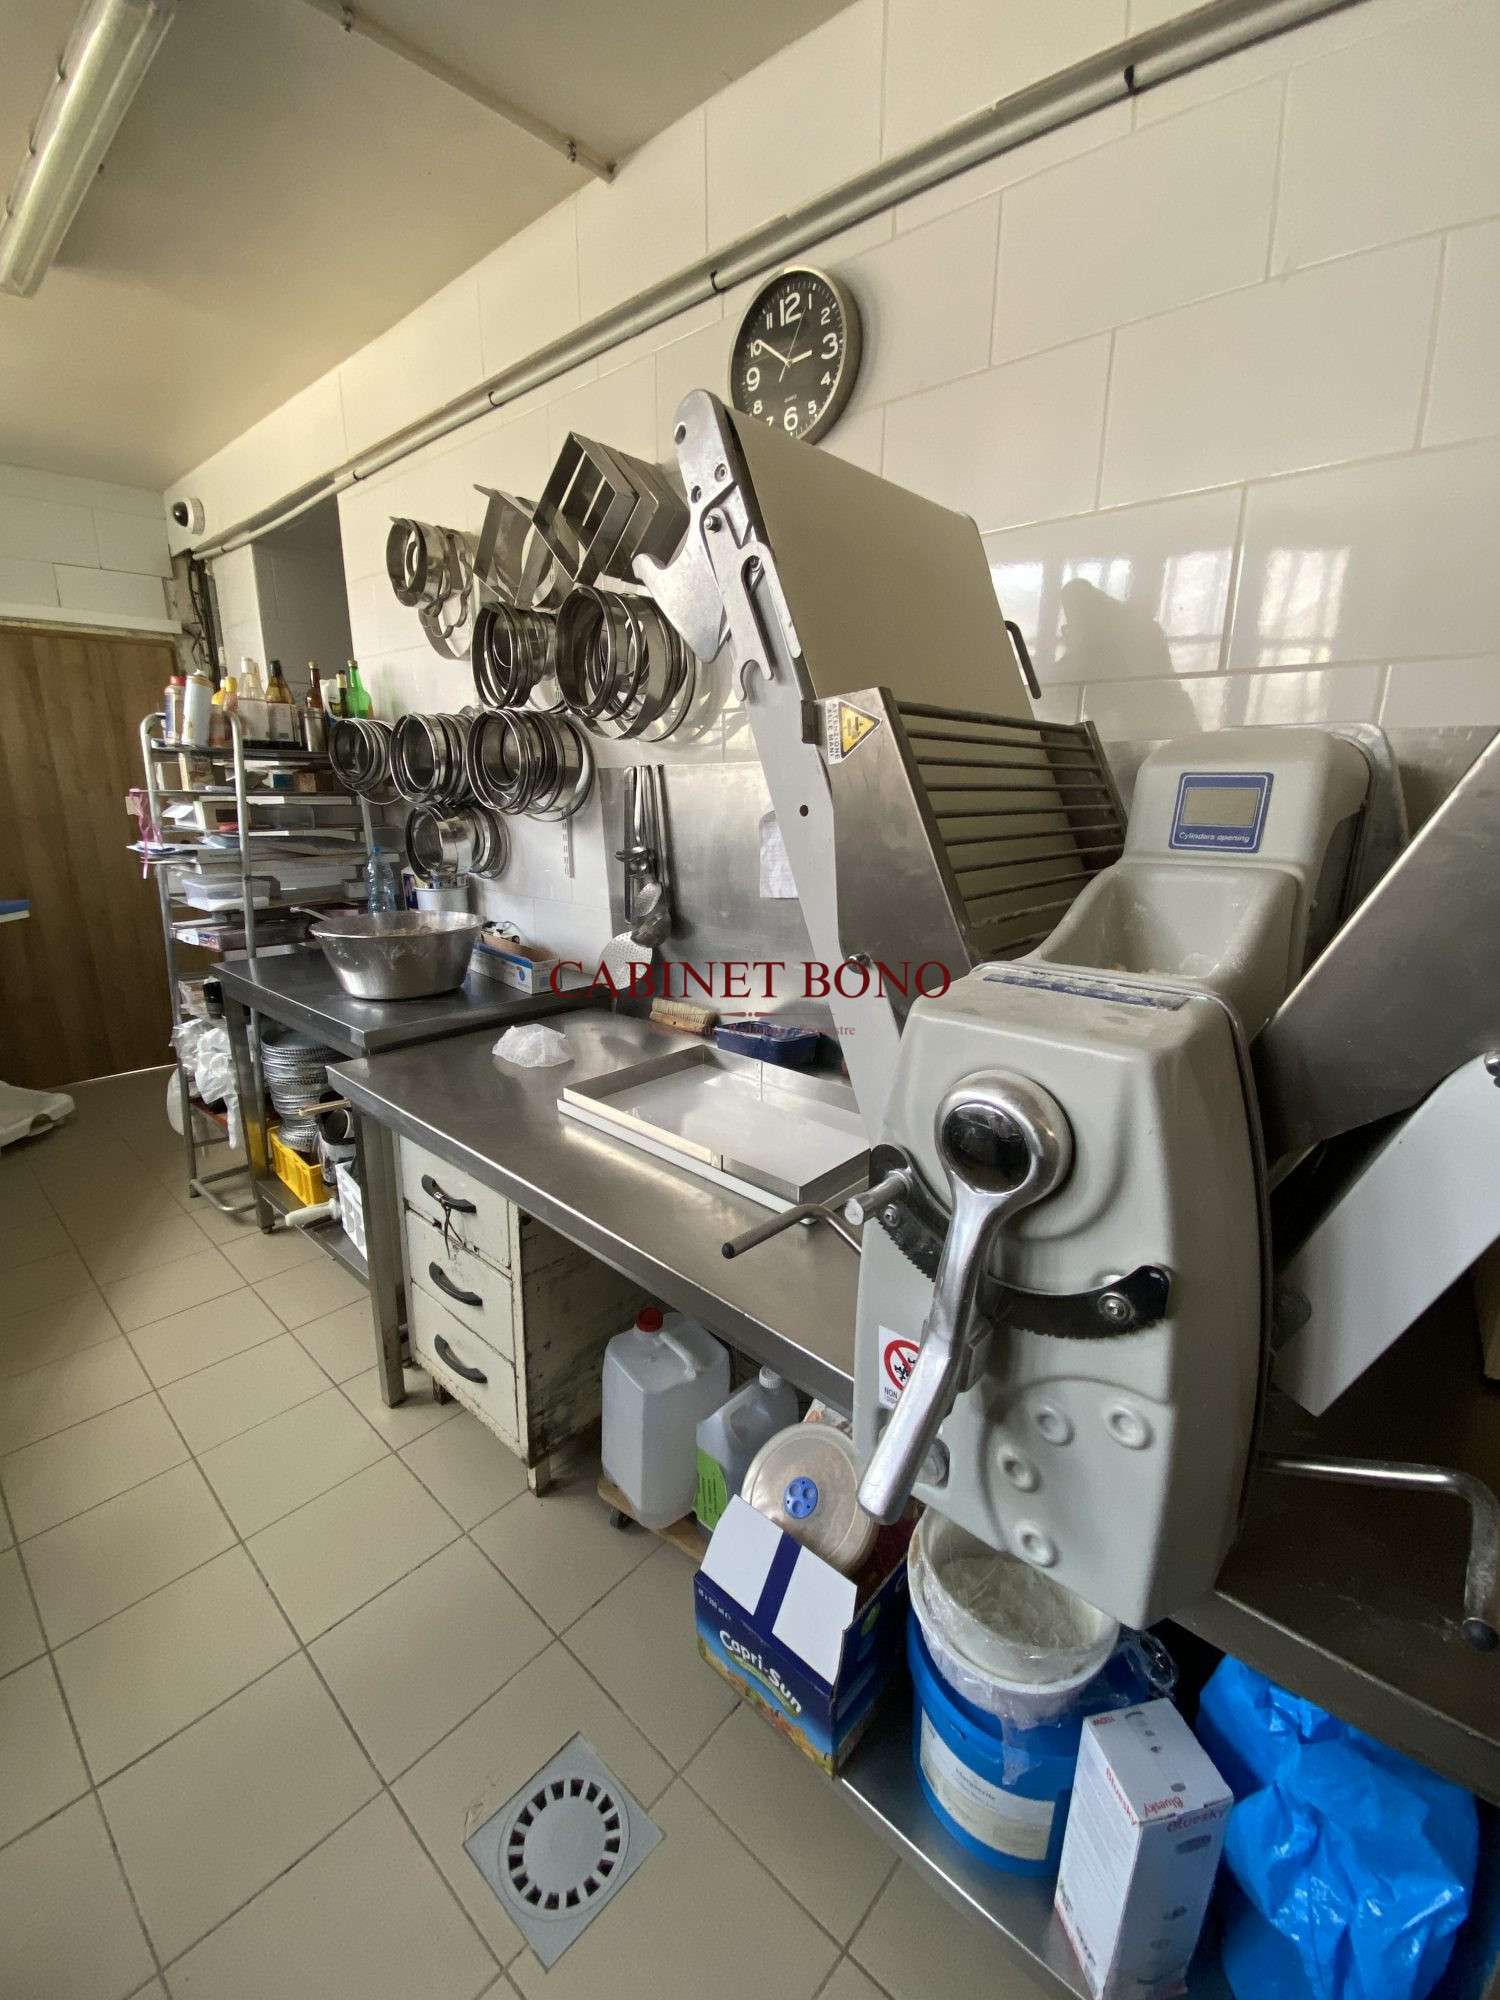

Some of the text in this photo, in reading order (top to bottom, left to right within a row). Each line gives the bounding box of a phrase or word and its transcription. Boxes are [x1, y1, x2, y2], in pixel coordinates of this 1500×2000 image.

[779, 292, 802, 327] 12
[808, 293, 812, 310] 1
[766, 312, 773, 331] 11
[820, 307, 831, 326] 2
[750, 340, 762, 358] 10
[821, 332, 838, 360] 3
[746, 367, 760, 391] 9
[820, 371, 830, 386] 4
[753, 400, 763, 415] 8
[808, 400, 817, 414] 5
[766, 416, 774, 427] 7
[784, 406, 798, 431] 6
[885, 1387, 898, 1399] NON
[719, 1630, 802, 1713] Capri-Sun
